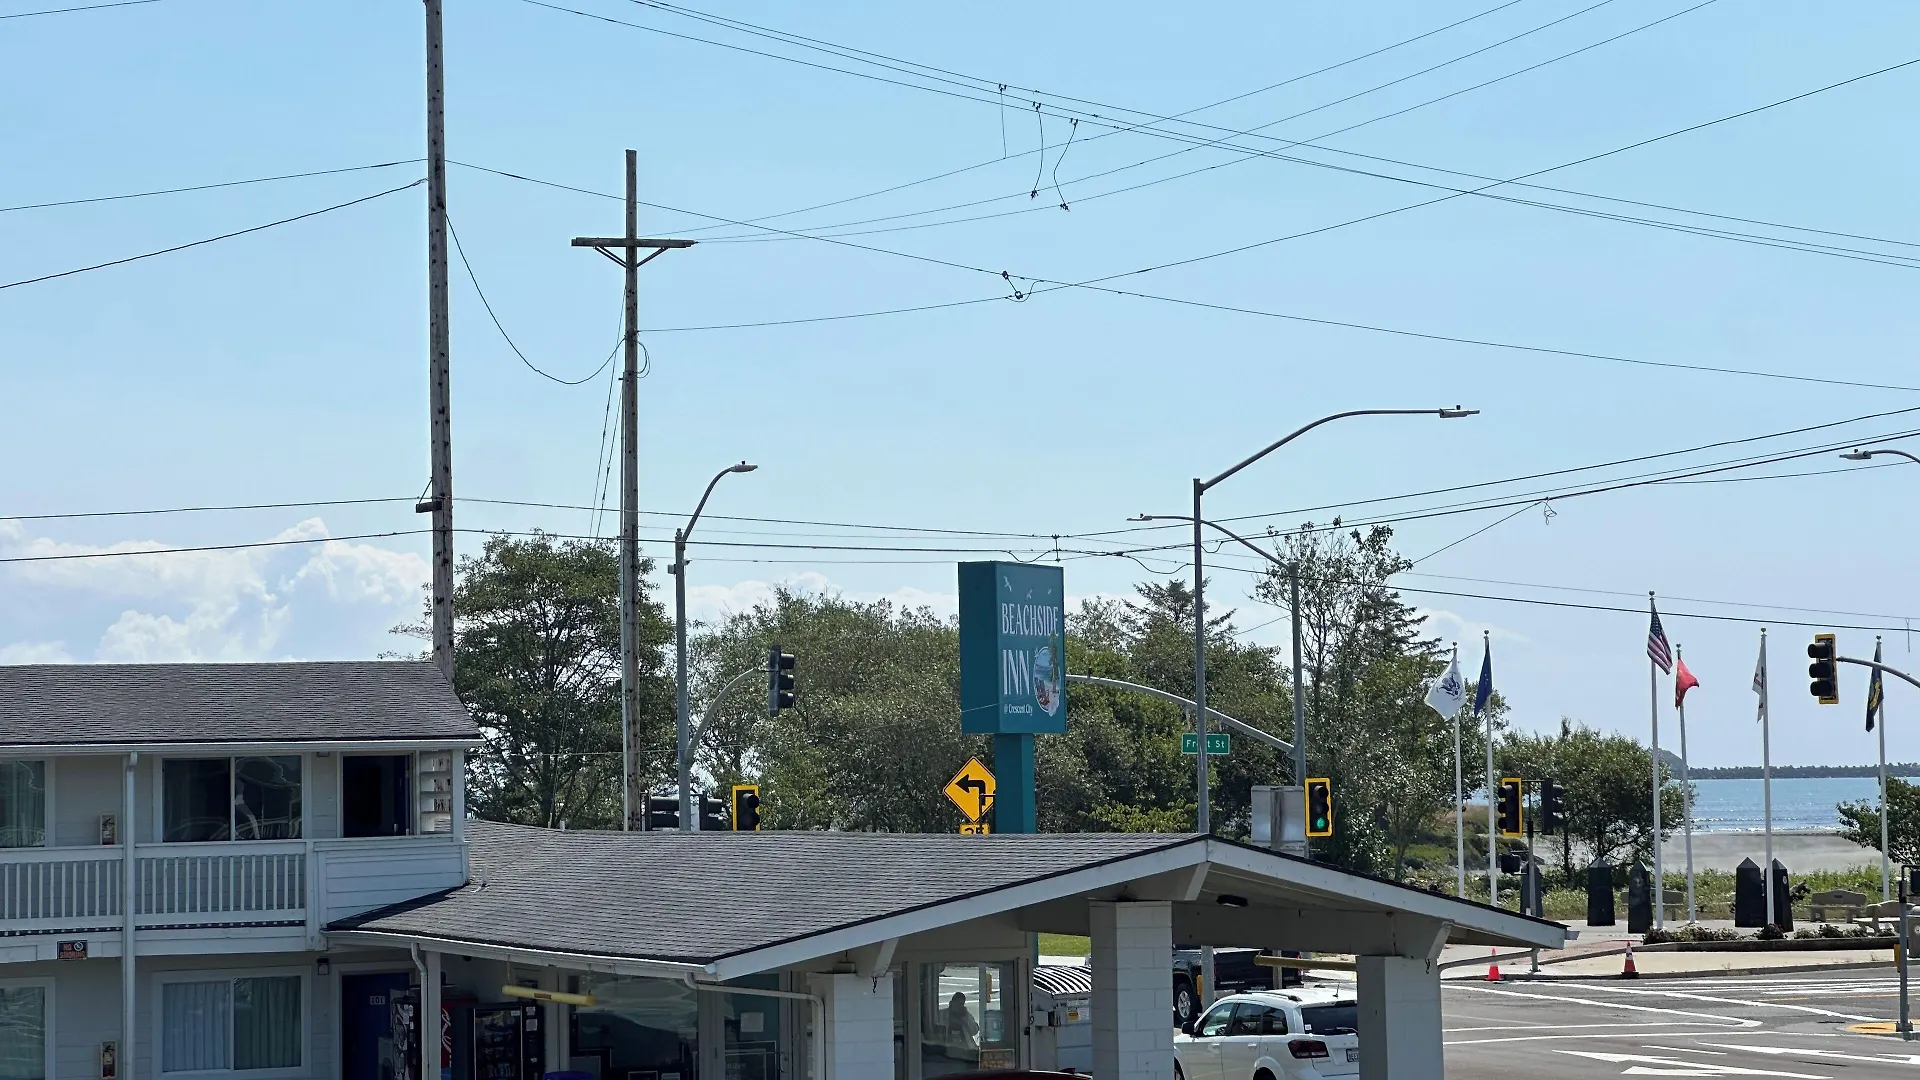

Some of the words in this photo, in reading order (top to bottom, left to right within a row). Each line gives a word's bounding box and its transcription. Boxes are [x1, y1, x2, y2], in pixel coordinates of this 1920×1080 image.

[1001, 602, 1059, 637] BEACHSIDE
[1002, 649, 1030, 696] INN
[1009, 703, 1025, 714] Crescent
[1186, 739, 1211, 748] Frt
[1215, 739, 1225, 748] St
[63, 943, 72, 951] NO
[59, 951, 86, 959] SMOKING
